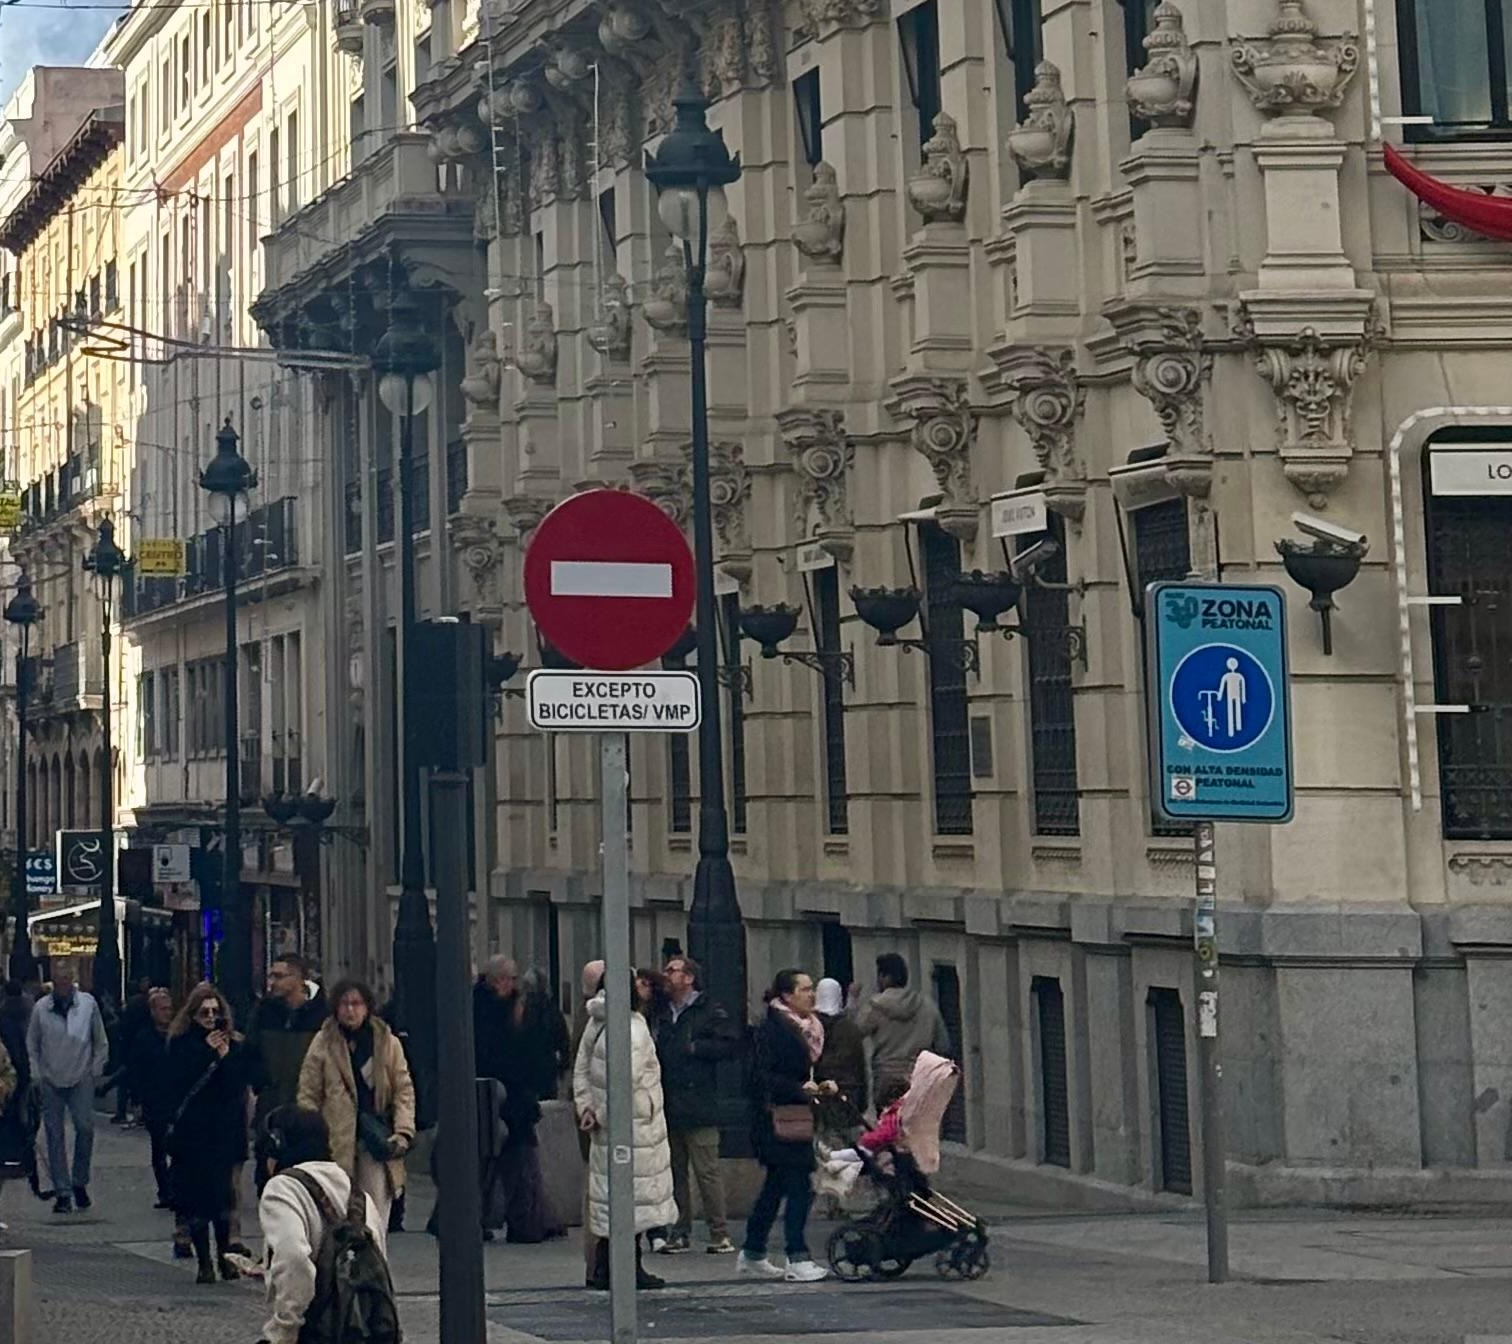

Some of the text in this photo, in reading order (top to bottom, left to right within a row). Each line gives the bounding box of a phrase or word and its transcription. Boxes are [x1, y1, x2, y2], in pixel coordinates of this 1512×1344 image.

[1488, 463, 1512, 480] LO
[1201, 599, 1273, 620] ZONA
[1201, 618, 1273, 631] PEATONAL
[572, 681, 657, 699] EXCEPTO
[538, 703, 692, 721] BICICLETAS/ VMP
[1167, 764, 1284, 777] CON ALTA DENSIDAD
[1195, 777, 1256, 789] PEATONAL
